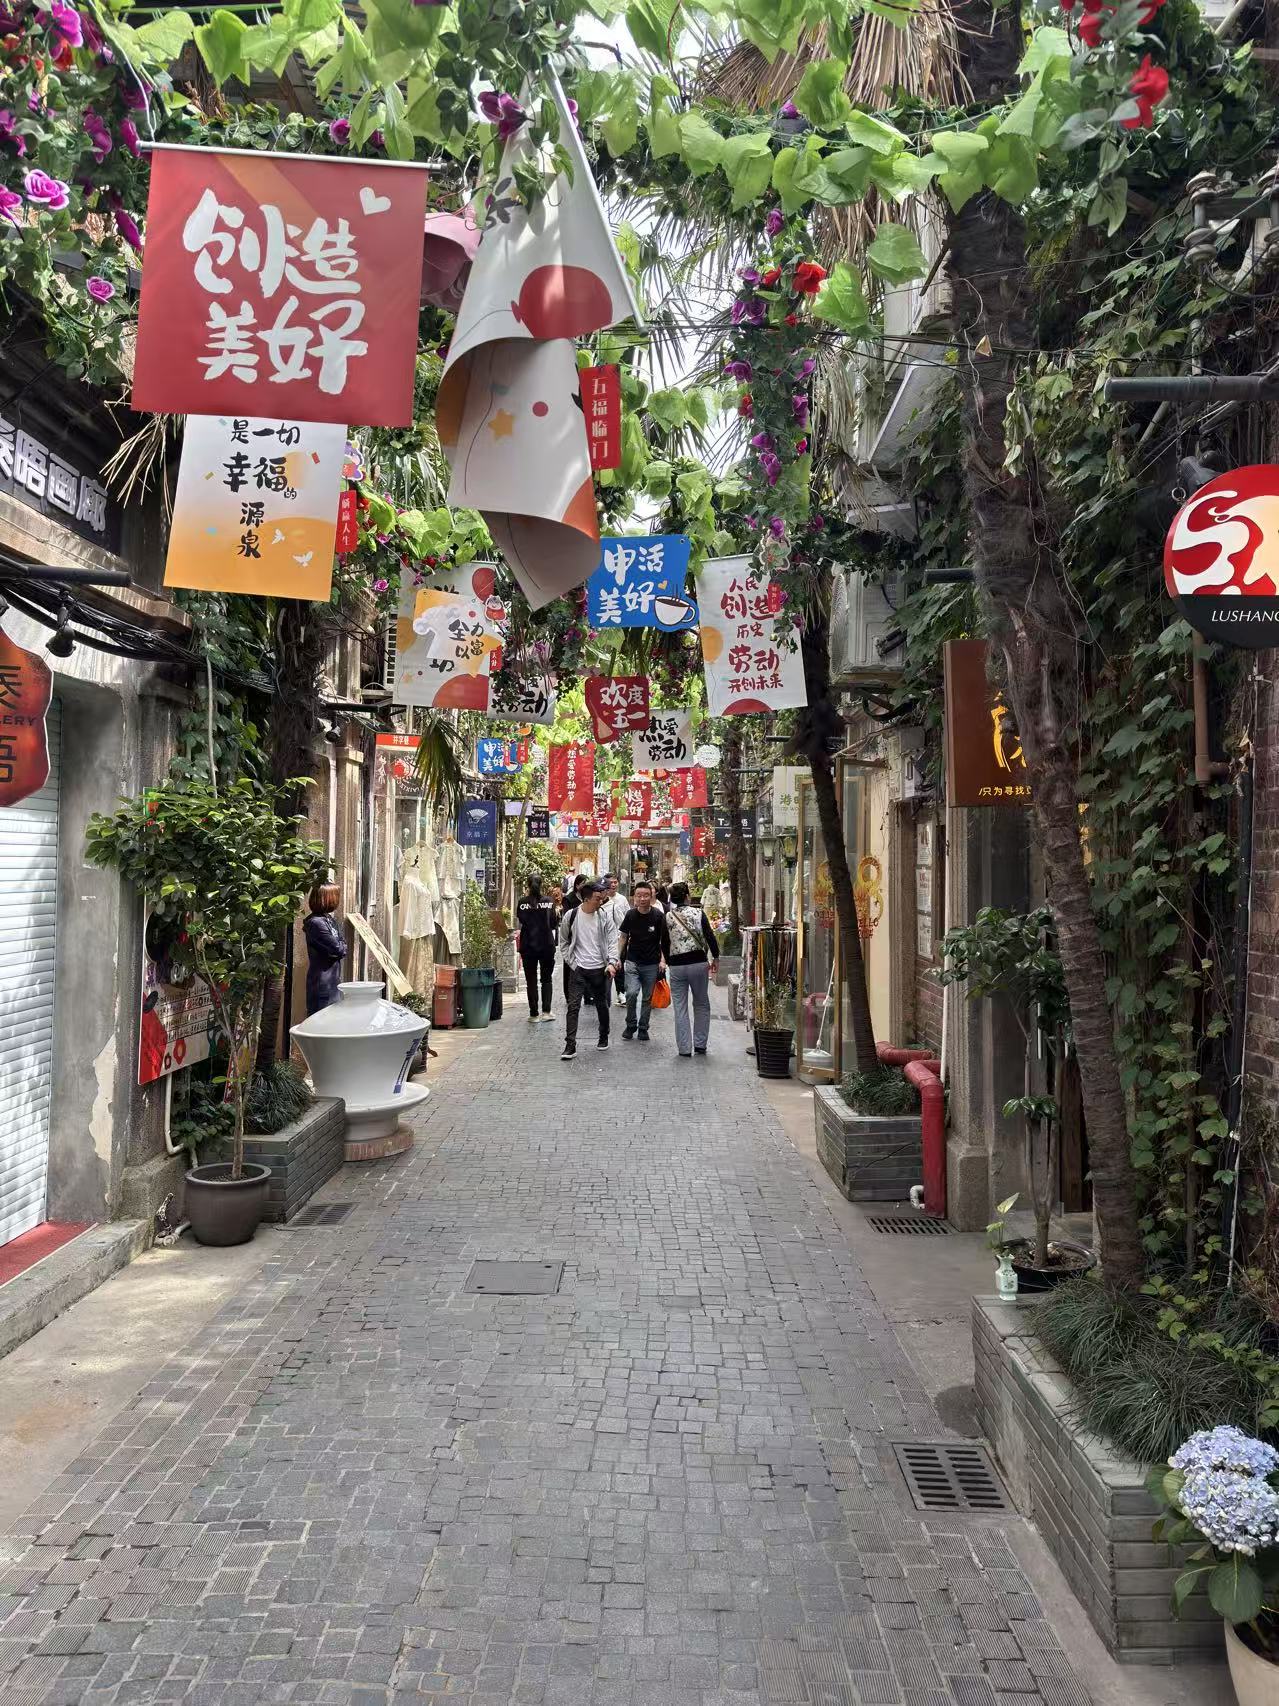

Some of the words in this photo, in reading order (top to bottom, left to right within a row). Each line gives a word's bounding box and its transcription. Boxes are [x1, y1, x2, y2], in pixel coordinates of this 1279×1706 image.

[182, 188, 362, 299] 创造
[197, 295, 369, 395] 美好
[230, 418, 301, 447] 是一切
[592, 376, 608, 460] 五福临门
[222, 452, 297, 499] 幸福的
[237, 501, 265, 559] 源泉
[604, 543, 665, 586] 申活
[729, 576, 759, 593] 人民
[596, 581, 656, 624] 美好
[720, 590, 775, 621] 创造
[448, 618, 484, 641] 全力
[736, 621, 765, 639] 历史
[728, 644, 780, 674] 劳动
[600, 679, 645, 708] 欢度
[728, 673, 784, 694] 开创未来
[0, 714, 35, 725] ERY
[611, 708, 646, 729] 五一
[639, 716, 679, 743] 热爱
[649, 738, 687, 761] 劳动
